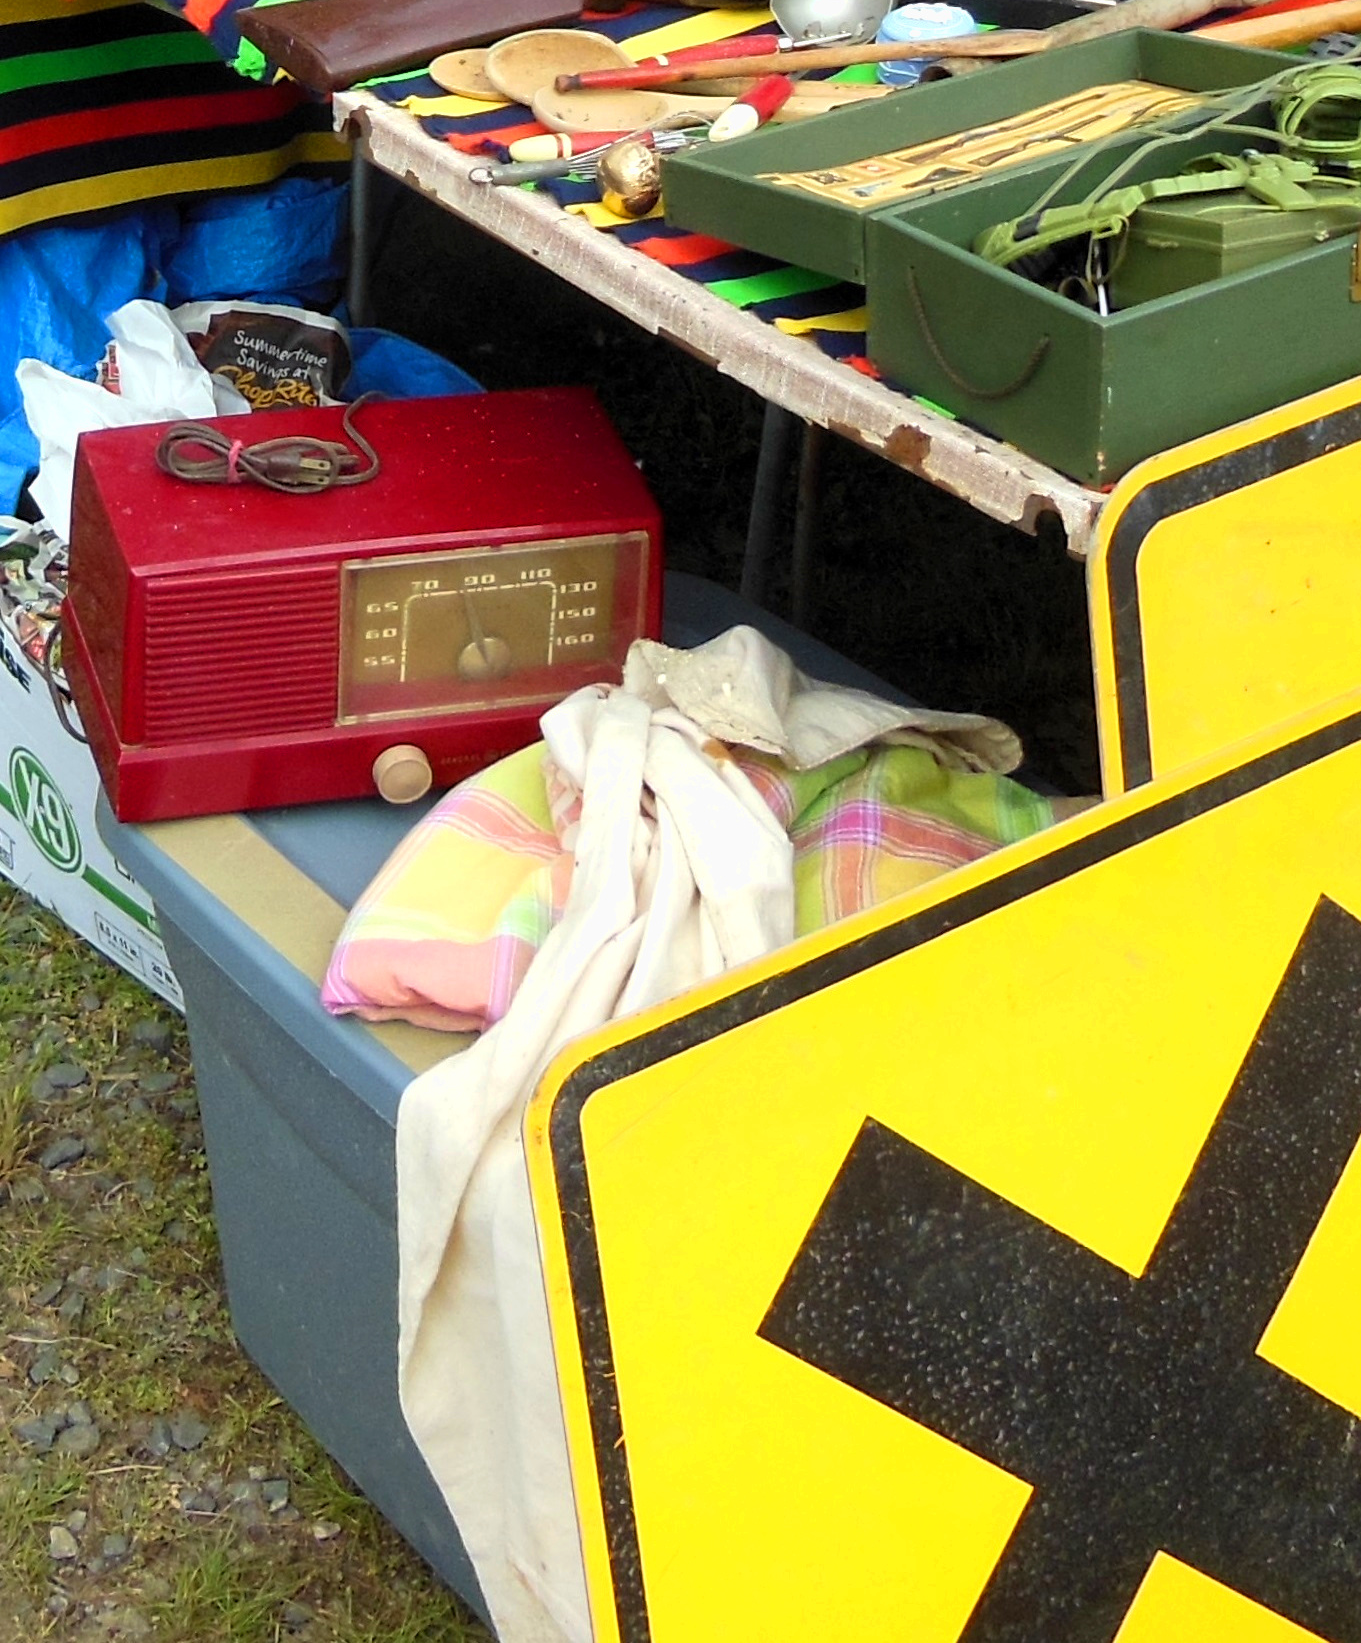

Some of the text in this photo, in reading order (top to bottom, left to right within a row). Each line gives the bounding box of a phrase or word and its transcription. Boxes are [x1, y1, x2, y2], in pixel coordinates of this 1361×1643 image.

[234, 330, 328, 368] Summertime
[236, 348, 311, 382] Savings at
[464, 573, 496, 585] 90
[520, 568, 552, 580] 110
[411, 579, 439, 590] 70
[560, 581, 597, 594] 130
[367, 601, 399, 614] 65
[558, 606, 596, 620] 150
[365, 627, 397, 640] 60
[557, 633, 595, 647] 160
[364, 655, 396, 668] 55
